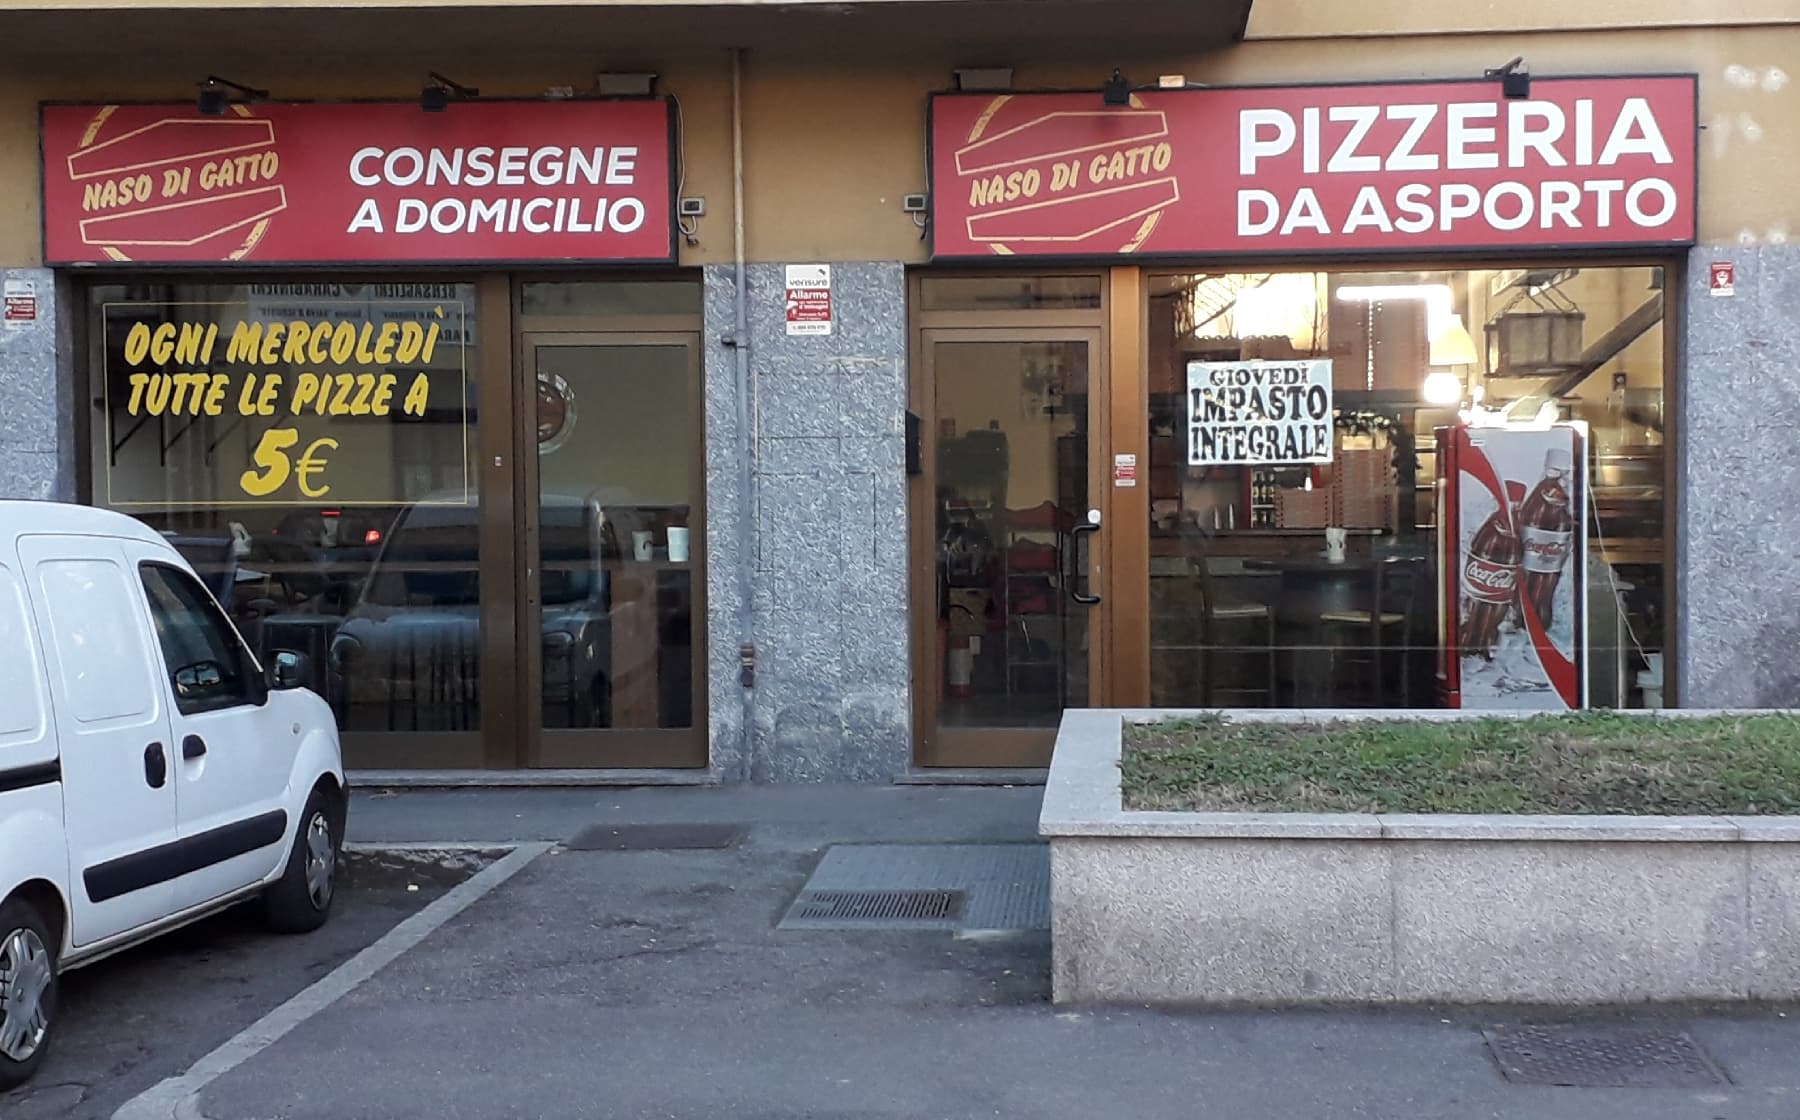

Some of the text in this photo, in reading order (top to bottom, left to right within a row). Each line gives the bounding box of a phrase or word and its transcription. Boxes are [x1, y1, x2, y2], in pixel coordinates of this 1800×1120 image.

[1239, 98, 1674, 175] PIZZERIA
[82, 150, 279, 211] NASO DI GATTO
[349, 146, 639, 186] CONSEGNE
[969, 142, 1173, 207] NASO DI GATTO
[346, 197, 646, 234] A DOMICILIO
[1237, 177, 1678, 236] DA ASPORTO
[789, 290, 828, 300] Allarme
[124, 305, 444, 366] OGNI MERCOLEDÌ
[128, 372, 430, 417] TUTTE LE PIZZE A
[1208, 362, 1310, 386] GIOVEDÌ
[1190, 384, 1328, 423] IMPASTO
[1190, 424, 1329, 461] INTEGRALE
